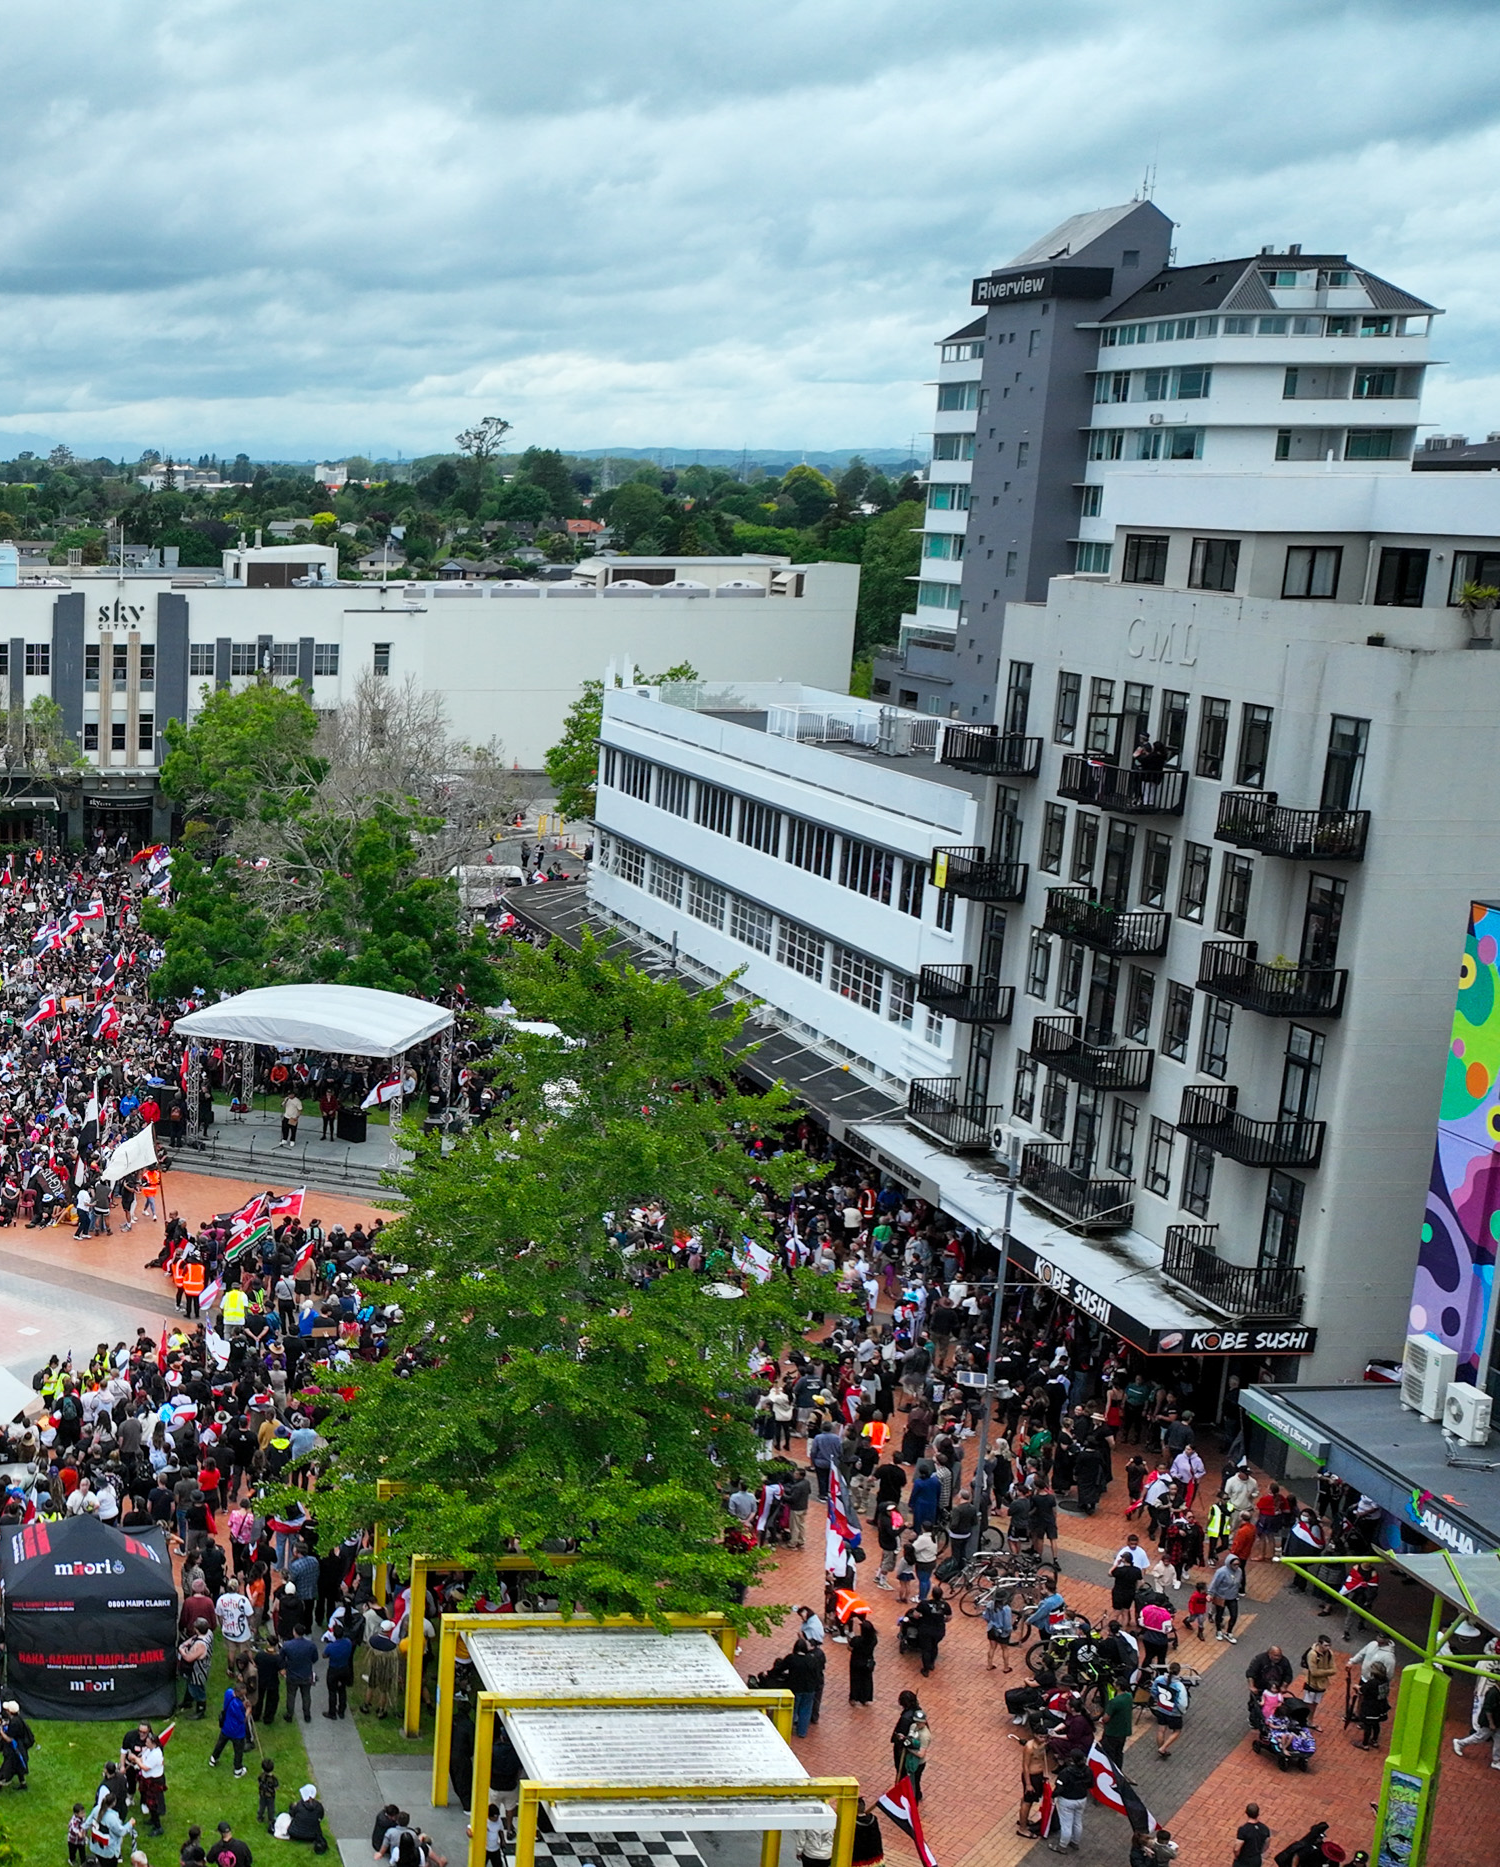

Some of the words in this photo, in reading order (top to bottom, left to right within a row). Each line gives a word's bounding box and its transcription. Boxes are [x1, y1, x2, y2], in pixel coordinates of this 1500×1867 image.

[977, 276, 1045, 300] Riverview
[98, 596, 145, 622] sky
[1034, 1256, 1070, 1295] KOBE
[1073, 1284, 1111, 1324] SUSHI
[1191, 1331, 1247, 1350] KOBE
[1254, 1331, 1309, 1349] SUSHI
[1267, 1413, 1290, 1435] Central
[1290, 1426, 1313, 1450] Library
[54, 1559, 112, 1576] māori
[107, 1600, 125, 1608] 0800
[145, 1599, 171, 1607] CLARKE
[70, 1677, 115, 1692] māori
